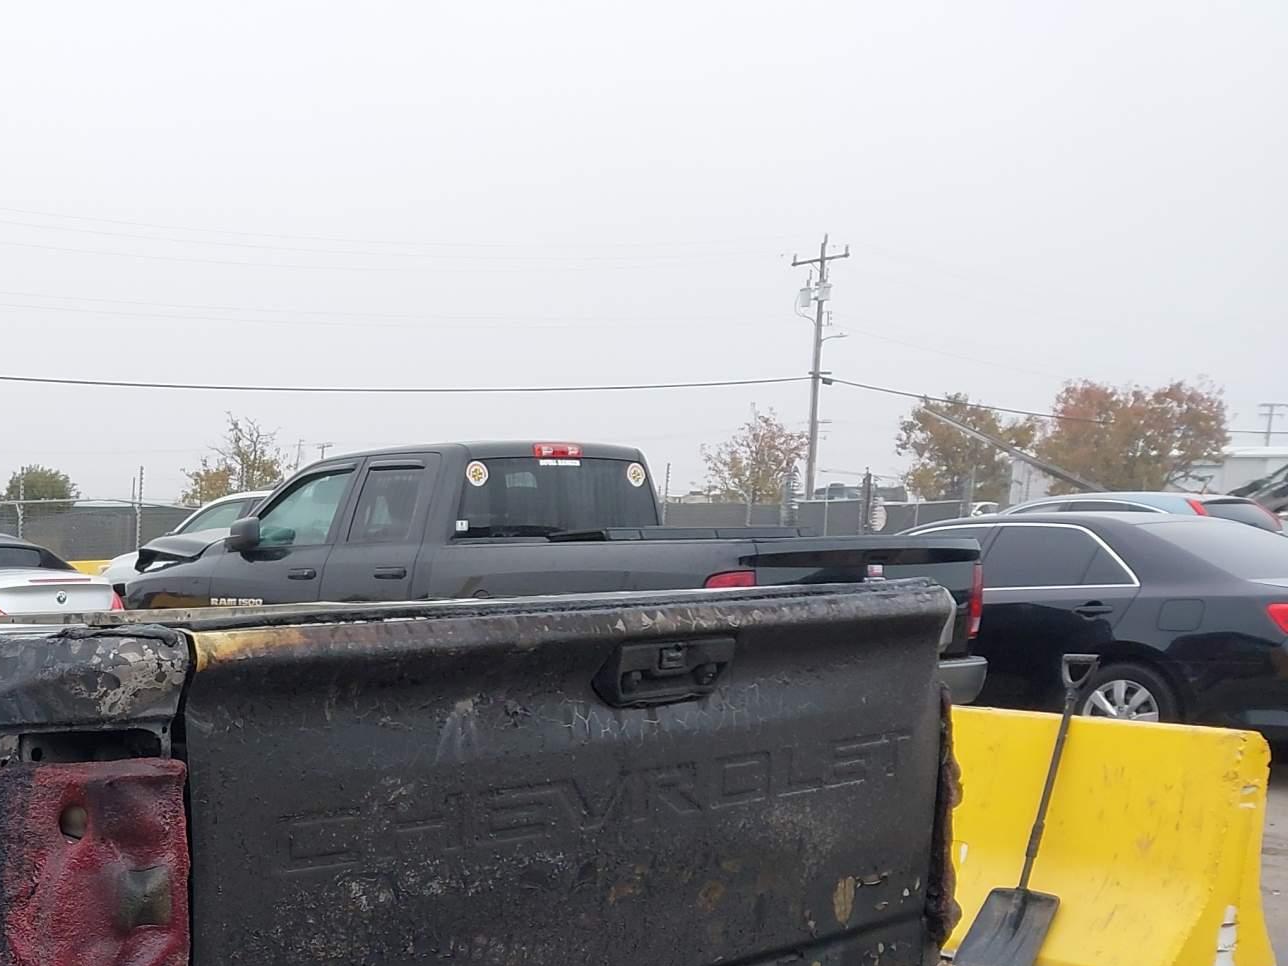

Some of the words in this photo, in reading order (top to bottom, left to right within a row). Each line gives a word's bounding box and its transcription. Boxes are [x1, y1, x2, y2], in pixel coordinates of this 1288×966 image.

[210, 597, 237, 606] RAM
[238, 597, 264, 607] 1500
[277, 730, 912, 875] CHEVROLET
